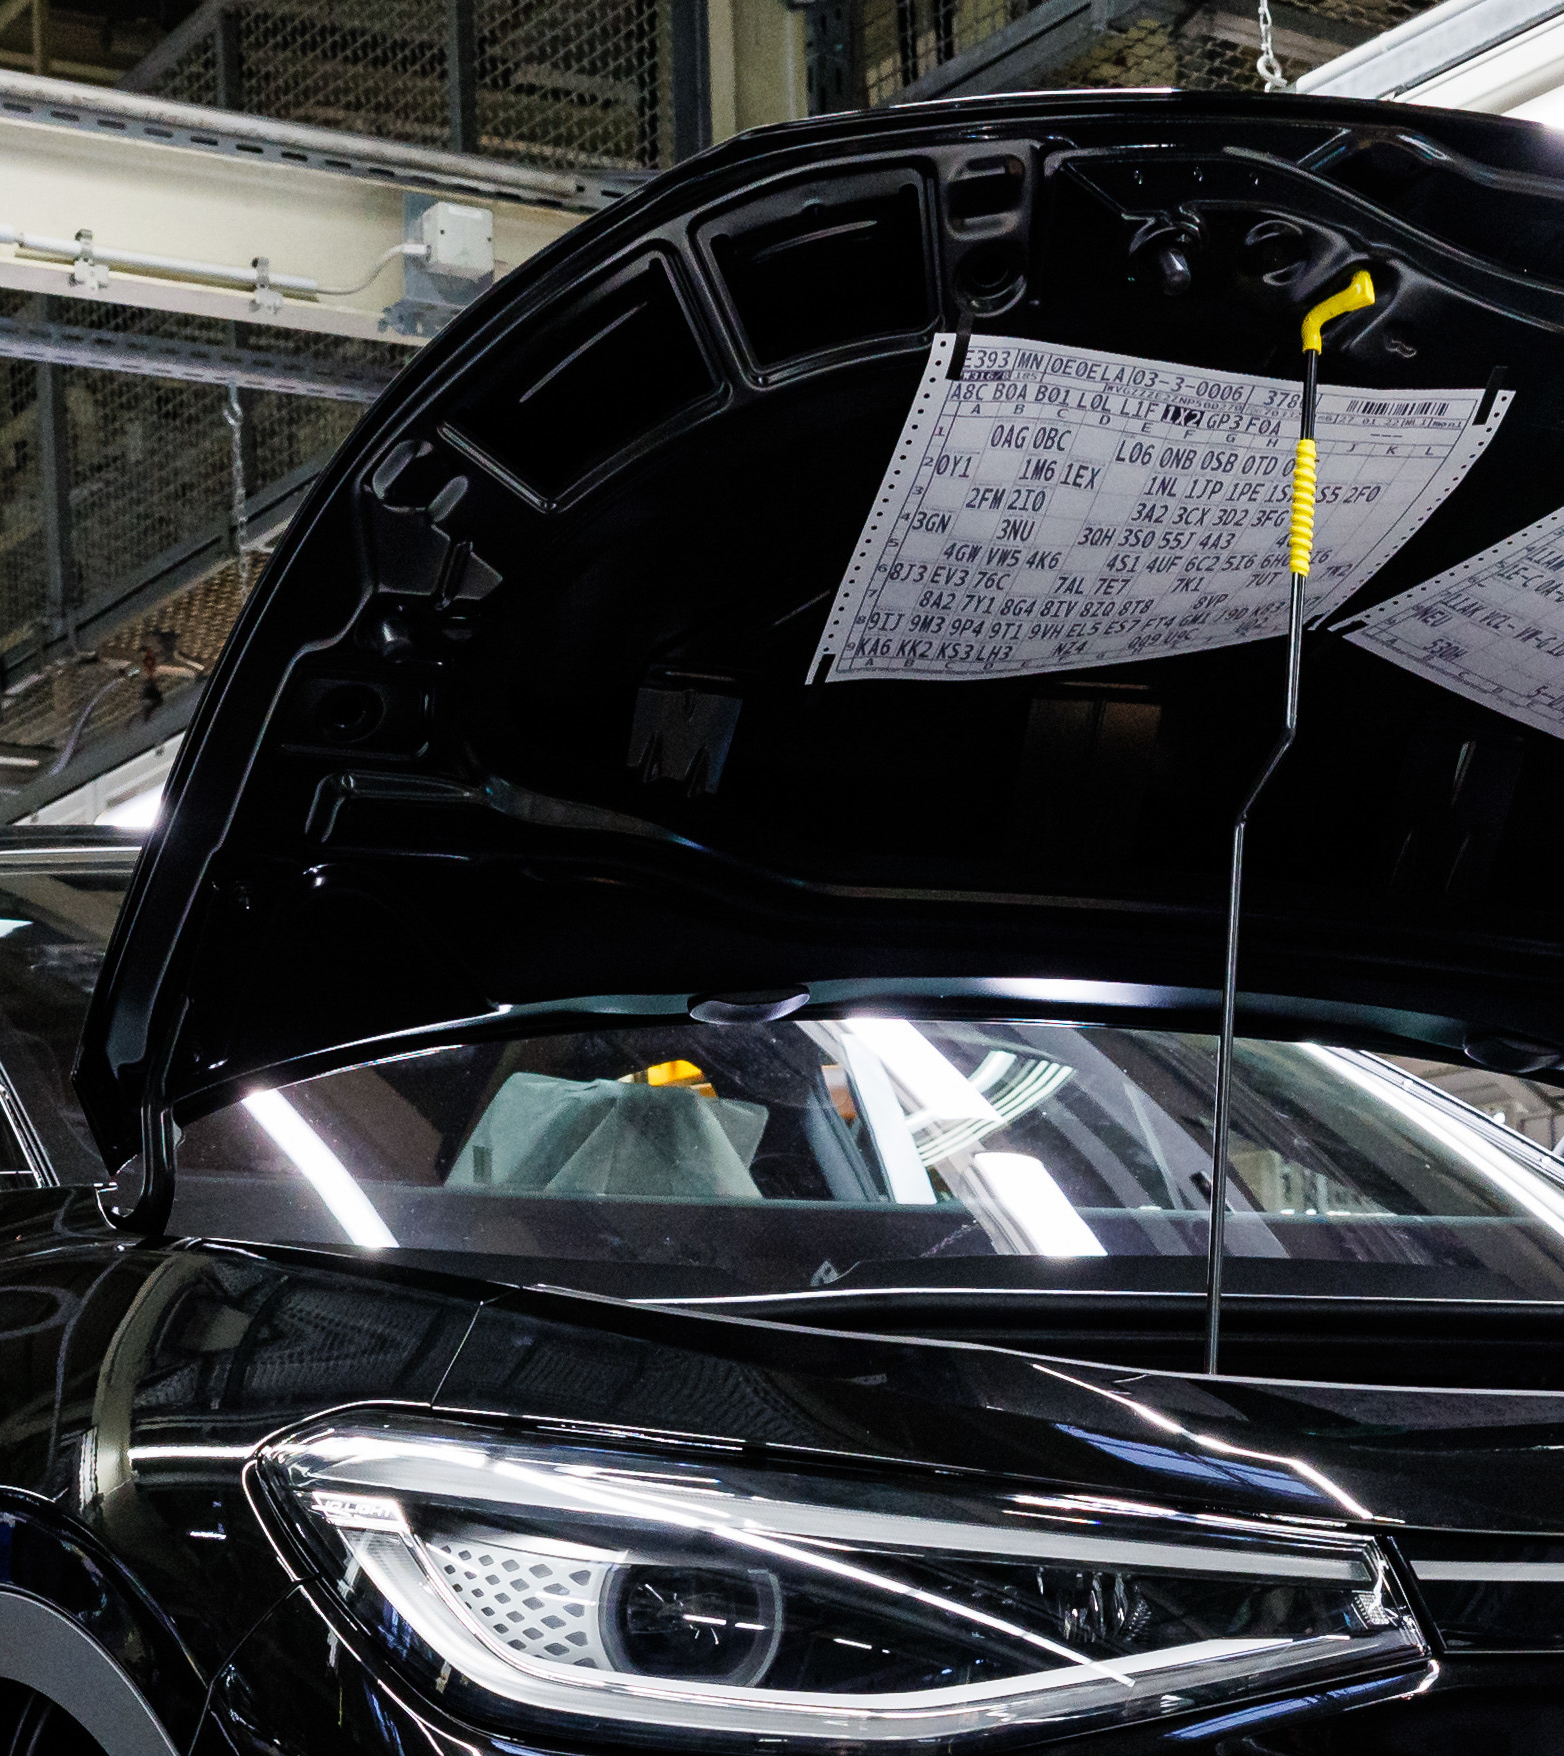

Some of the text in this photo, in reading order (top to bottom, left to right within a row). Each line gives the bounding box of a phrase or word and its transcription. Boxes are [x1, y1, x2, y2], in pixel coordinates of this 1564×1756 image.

[1018, 351, 1043, 370] MN
[1133, 370, 1245, 400] 03-3-0006
[1264, 390, 1303, 410] 378
[951, 383, 1281, 436] A8C B0A B01 L0L L1F 1X2 GP3 F0A
[971, 404, 1433, 455] A B C D E F G H J K L
[934, 427, 945, 436] 1
[991, 425, 1029, 449] 0AG
[1033, 427, 1071, 451] 0BC
[1116, 440, 1155, 466] L06
[1159, 447, 1197, 469] 0NB
[1201, 451, 1238, 473] 0SB
[1242, 456, 1278, 475] 0TD
[922, 457, 933, 466] 2
[937, 454, 972, 478] 0Y1
[1019, 458, 1057, 481] 1M6
[1060, 463, 1102, 489] 1EX
[1144, 476, 1177, 497] 1NL
[1185, 478, 1224, 500] 1JP
[1226, 483, 1265, 502] 1PE
[1343, 486, 1381, 503] 2F0
[912, 486, 924, 494] 3
[966, 487, 1006, 510] 2FM
[1131, 503, 1169, 524] 3A2
[1173, 506, 1211, 526] 3CX
[1212, 509, 1248, 526] 3D2
[1251, 510, 1289, 527] 3FG
[901, 511, 1235, 549] 4 3GN 3NU 3QH 3S0 55J 4A3
[888, 539, 1257, 573] 5 4GW VW5 4K6 4S1 4UF 6C2 5I6
[878, 563, 1282, 595] 6 8J3 EV3 76C 7AL 7E7 7K1 7UT
[867, 589, 878, 597] 7
[919, 590, 956, 610] 8A2
[961, 594, 996, 614] 7Y1
[1000, 599, 1037, 617] 8G4
[1040, 601, 1077, 617] 8IV
[1118, 599, 1154, 616] 8T8
[1193, 594, 1228, 610] 8VP
[868, 612, 904, 631] 9IJ
[909, 615, 945, 633] 9M3
[950, 618, 985, 636] 9P4
[989, 623, 1023, 639] 9T1
[1028, 623, 1064, 639] 9VH
[1066, 622, 1102, 637] EL5
[1103, 620, 1141, 634] ES7
[1141, 616, 1177, 631] FT4
[856, 638, 892, 656] KA6
[896, 639, 933, 657] KK2
[938, 642, 974, 660] KS3
[975, 644, 1013, 661] LH3
